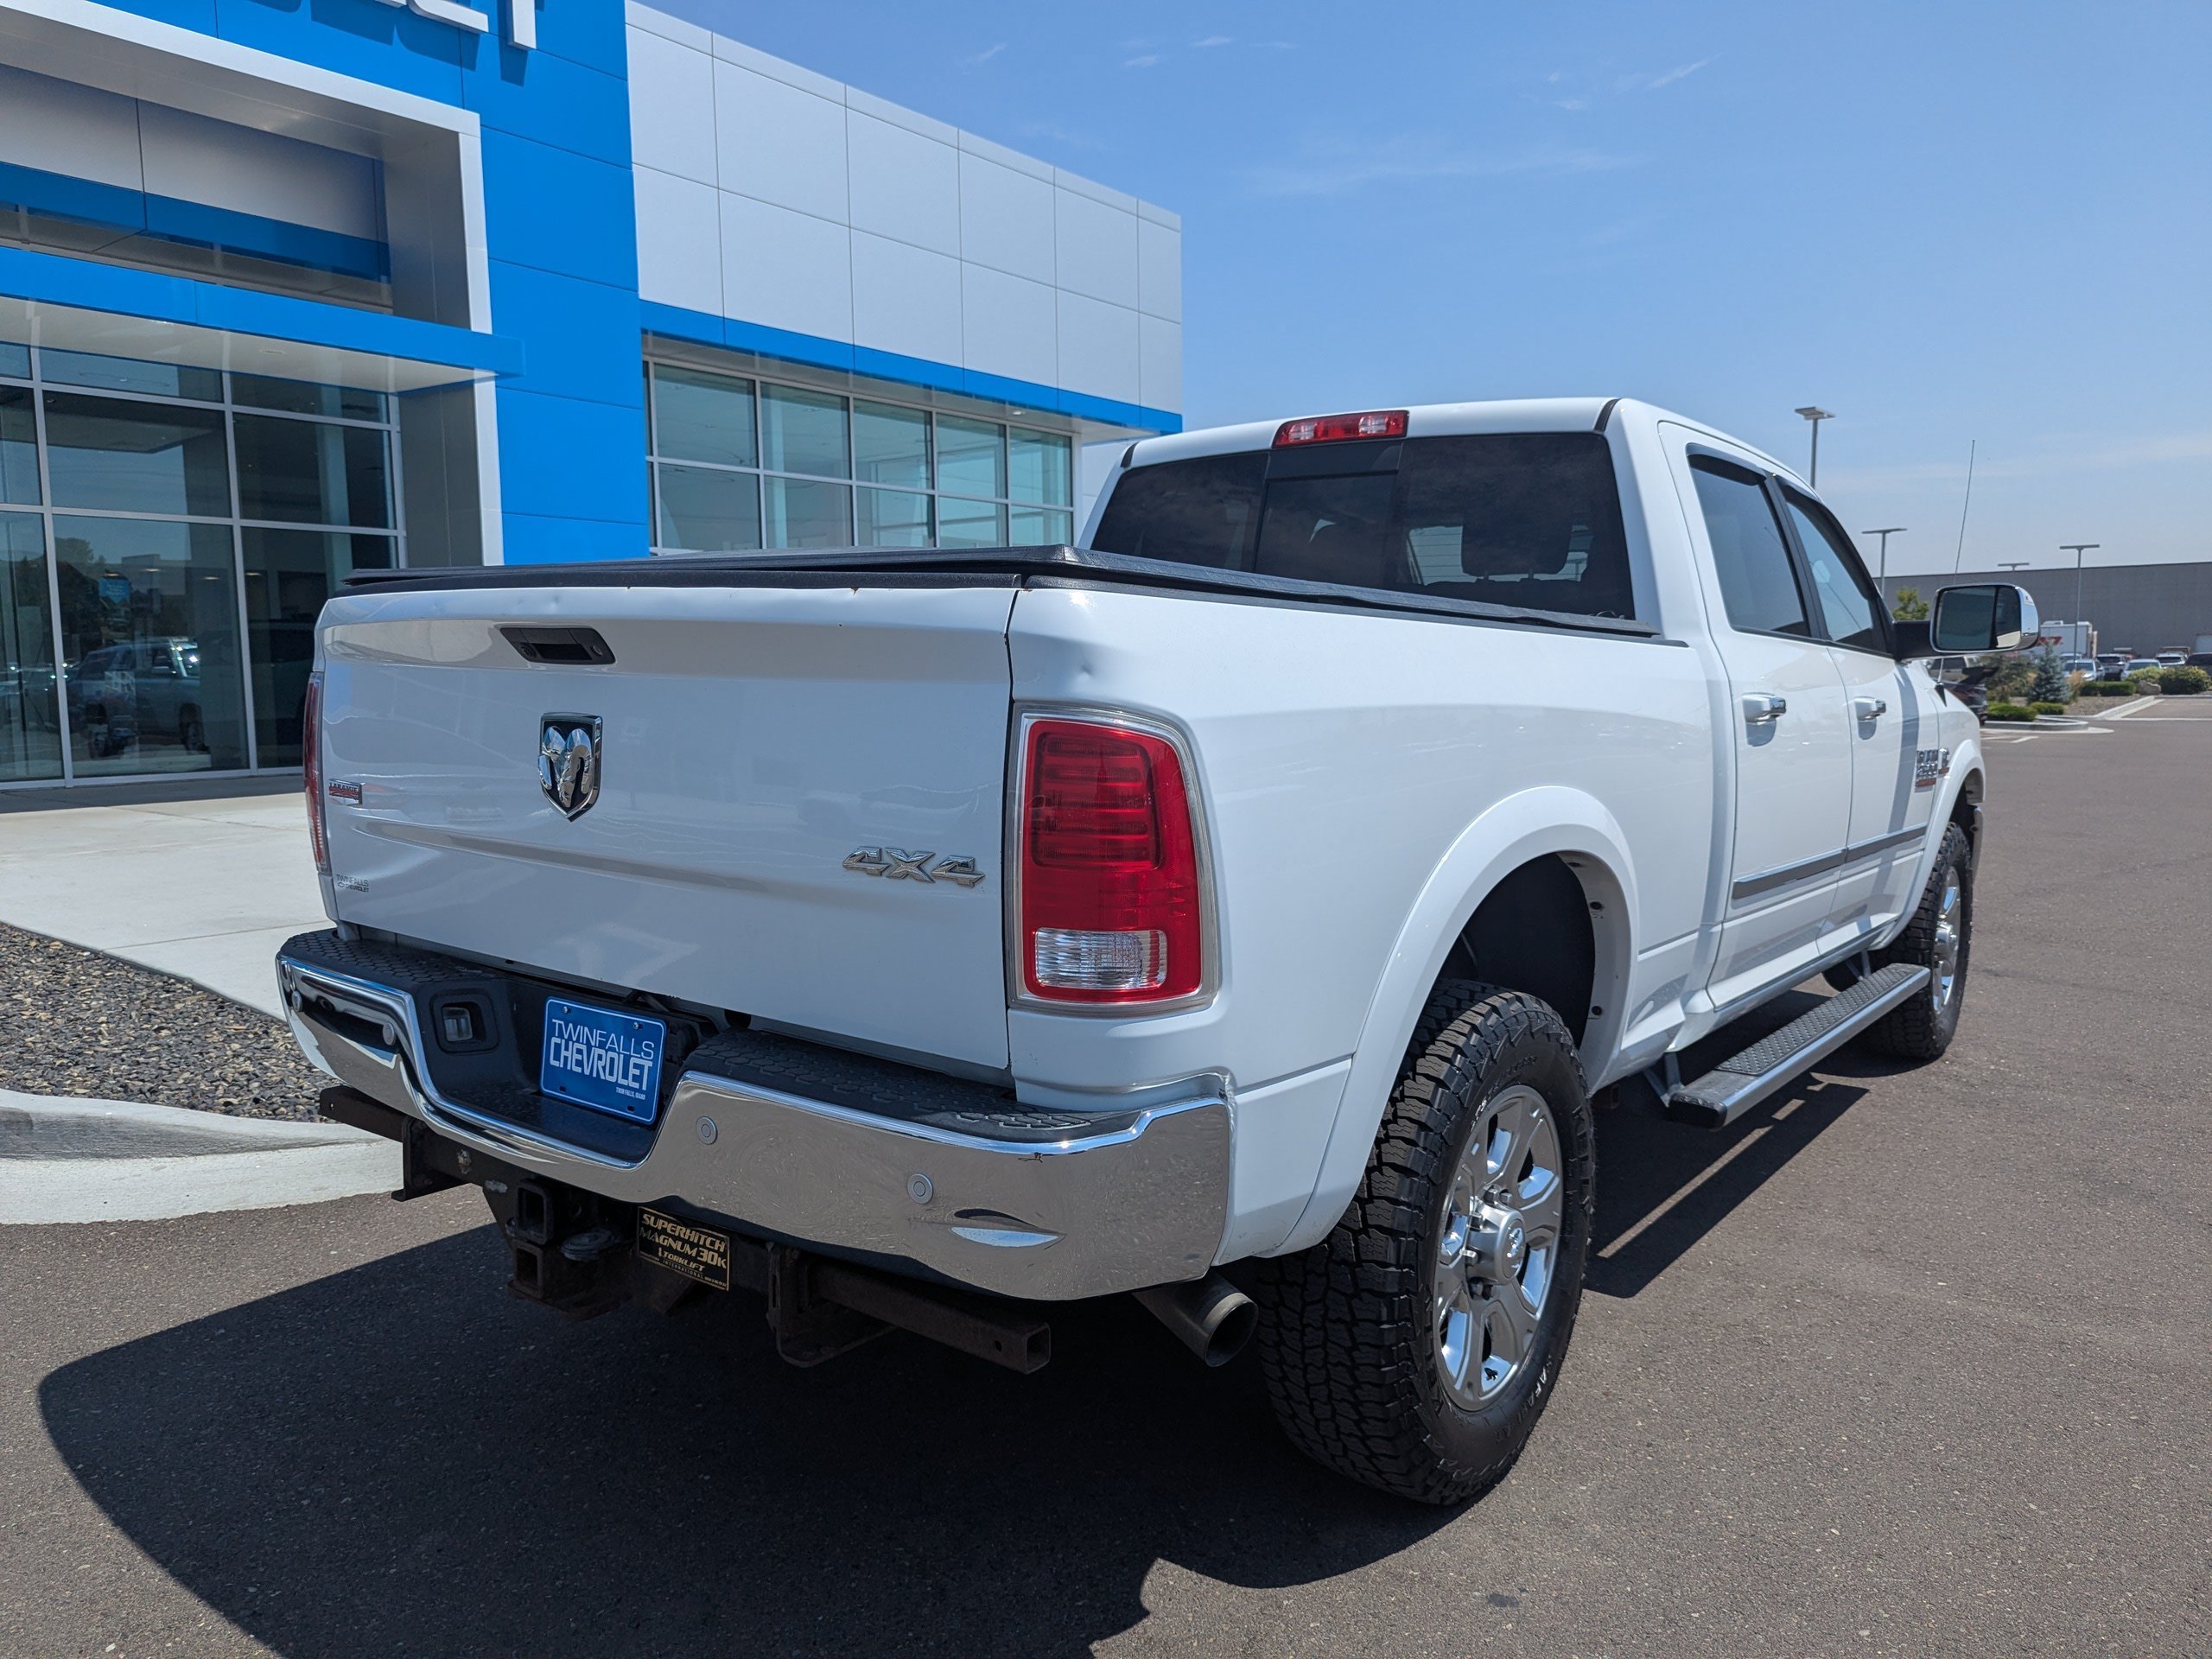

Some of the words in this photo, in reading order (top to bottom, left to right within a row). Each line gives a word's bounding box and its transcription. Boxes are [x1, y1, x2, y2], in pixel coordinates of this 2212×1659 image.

[550, 1036, 653, 1091] CHEVROLET
[639, 1226, 698, 1257] MAGNUM
[641, 1213, 726, 1253] SUPERHITCH
[664, 1250, 705, 1272] TORKLIFT
